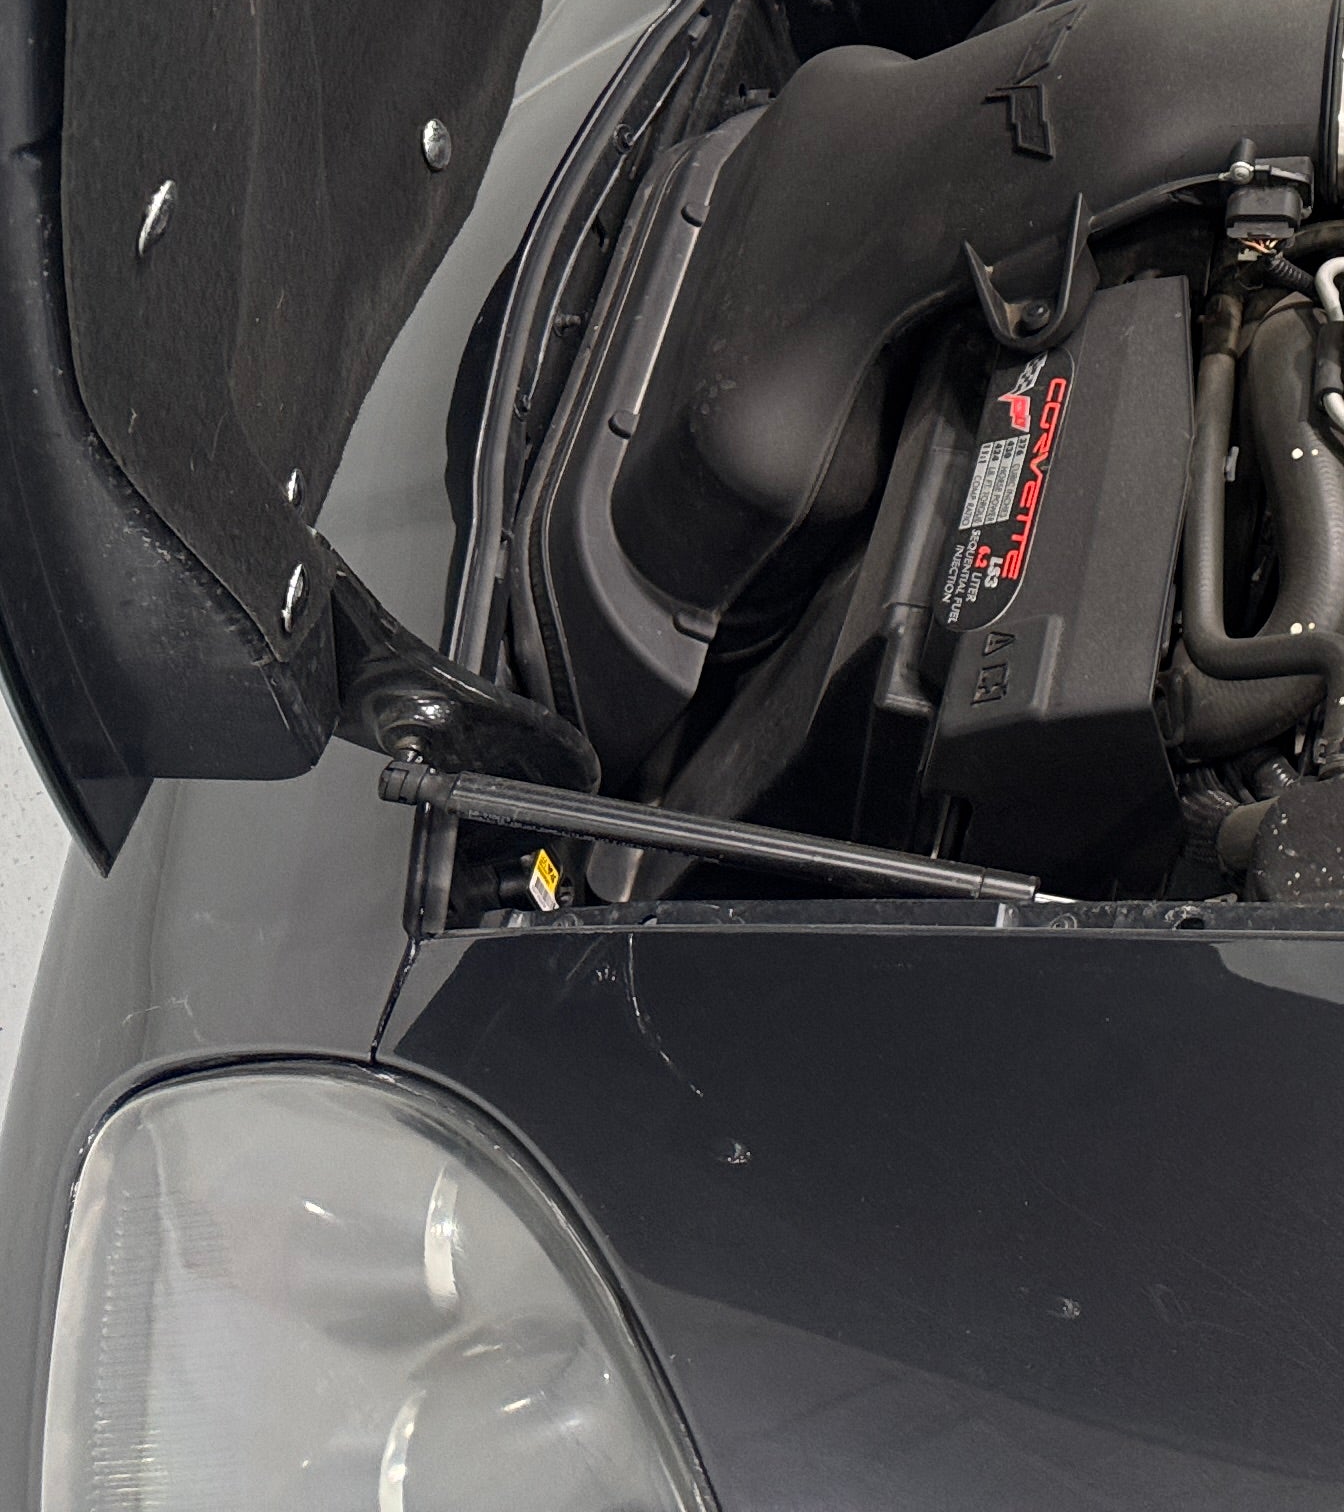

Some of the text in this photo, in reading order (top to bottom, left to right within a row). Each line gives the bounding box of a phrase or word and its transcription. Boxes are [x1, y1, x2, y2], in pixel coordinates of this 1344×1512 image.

[1001, 378, 1066, 580] CORVETTE
[942, 544, 965, 603] INJECTION
[947, 529, 981, 624] SEQUENTIAL FUEL
[965, 545, 991, 603] 6.2 LITER
[984, 556, 1003, 588] LS3
